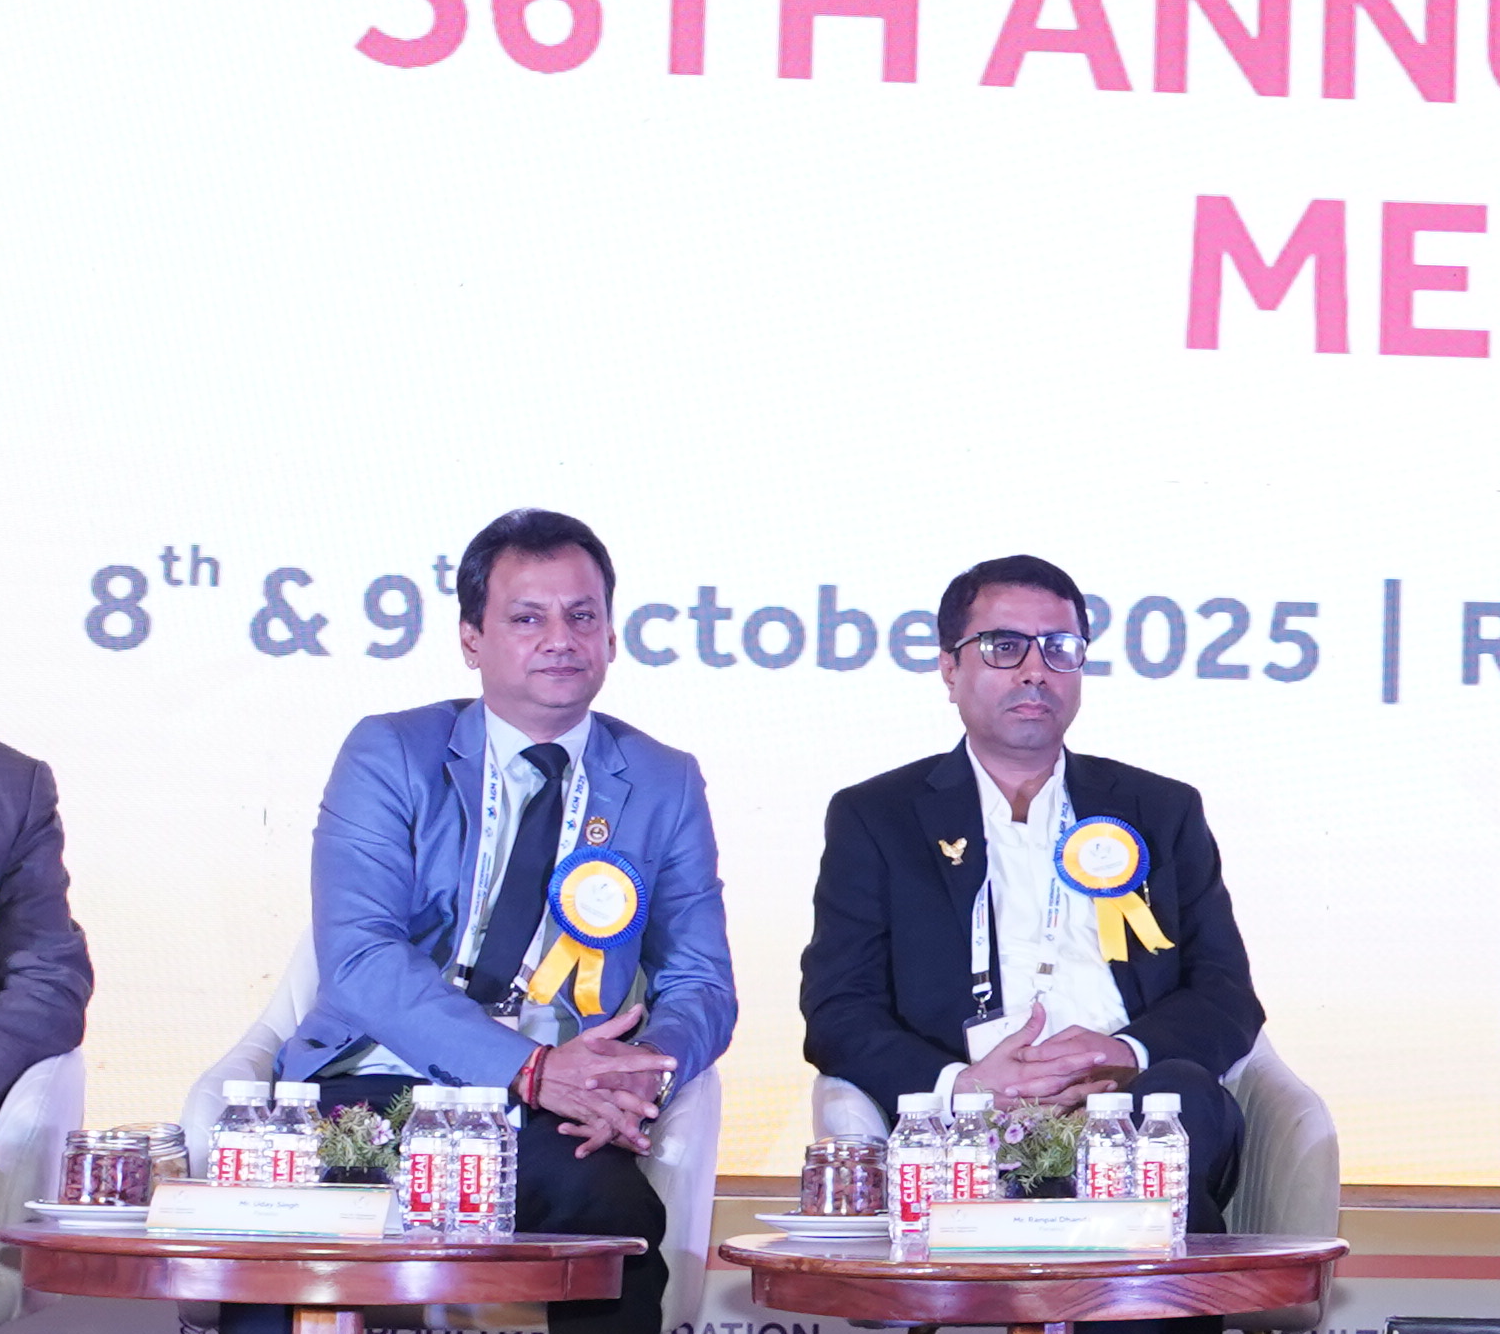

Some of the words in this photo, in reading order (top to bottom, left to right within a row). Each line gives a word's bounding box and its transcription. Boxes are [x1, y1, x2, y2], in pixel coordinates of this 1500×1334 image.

[84, 543, 222, 652] 8th
[249, 565, 332, 658] &
[363, 551, 460, 660] 9t
[622, 583, 944, 673] ctobe
[490, 781, 498, 802] AGM
[575, 774, 586, 795] 2025
[570, 796, 581, 815] AGM
[413, 1154, 426, 1193] CLEAR
[462, 1155, 476, 1194] CLEAR
[902, 1165, 916, 1203] CLEAR
[956, 1163, 969, 1199] CLEAR
[1145, 1161, 1159, 1198] CLEAR
